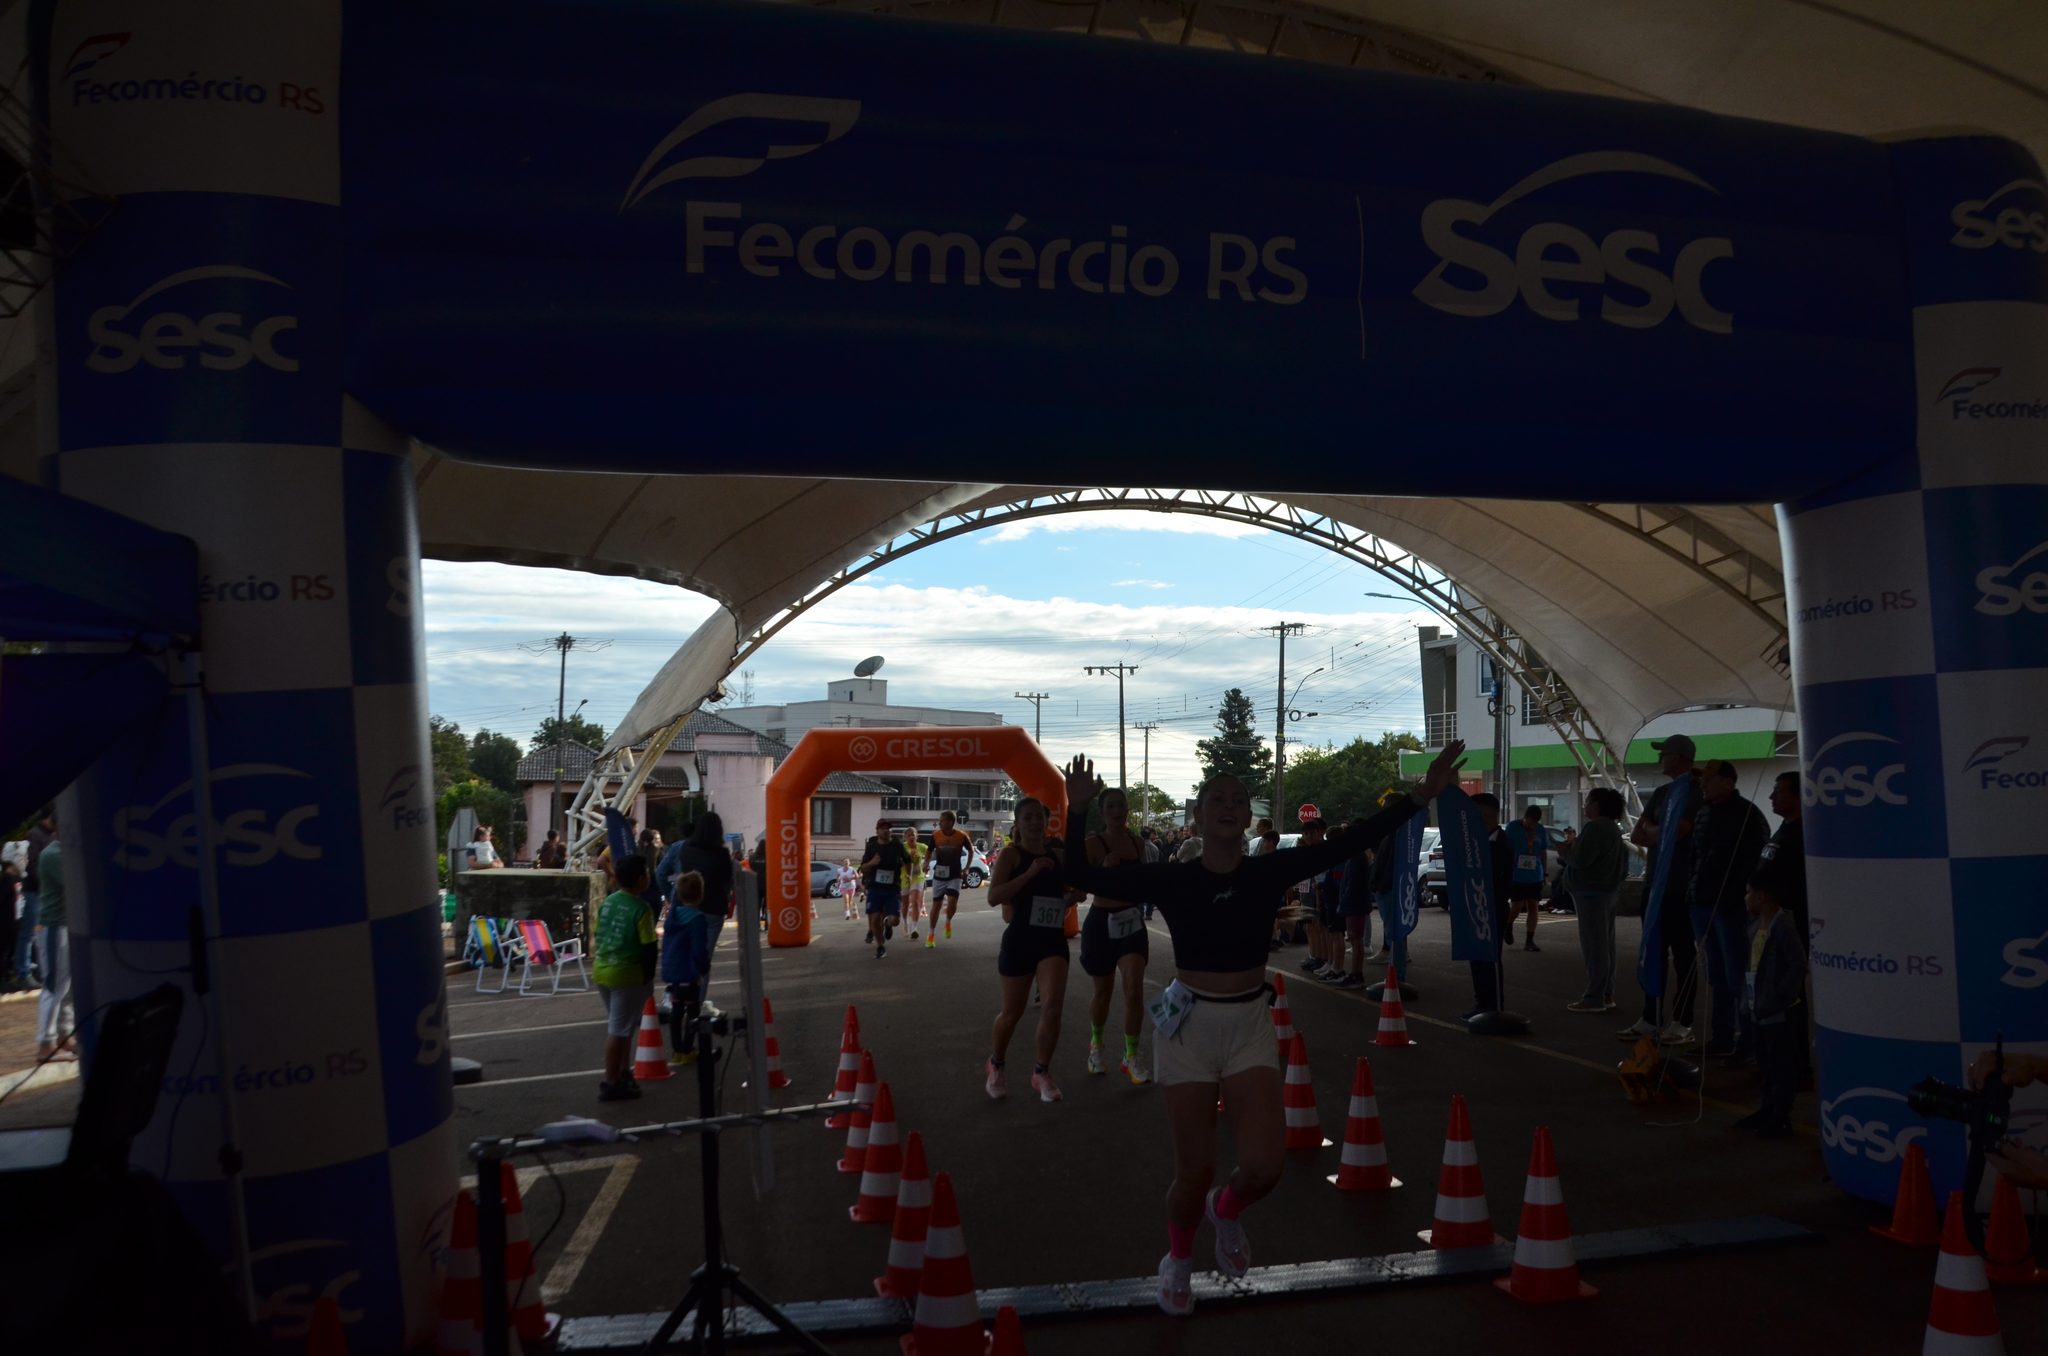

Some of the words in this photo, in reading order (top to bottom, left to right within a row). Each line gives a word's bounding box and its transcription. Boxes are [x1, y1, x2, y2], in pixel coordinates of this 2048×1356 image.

[73, 72, 266, 107] Fecomércio
[280, 83, 324, 114] RS
[685, 199, 1180, 297] Fecomércio
[1207, 231, 1309, 305] RS
[1411, 198, 1735, 335] Sesc
[85, 304, 300, 375] Sesc
[290, 574, 335, 602] RS
[1881, 589, 1918, 611] RS
[885, 736, 990, 760] CRESOL
[1299, 810, 1318, 818] PARE
[780, 811, 799, 901] CRESOL
[1037, 908, 1061, 925] 367
[1118, 918, 1135, 937] 77
[1906, 954, 1944, 977] RS
[326, 1048, 368, 1079] RS
